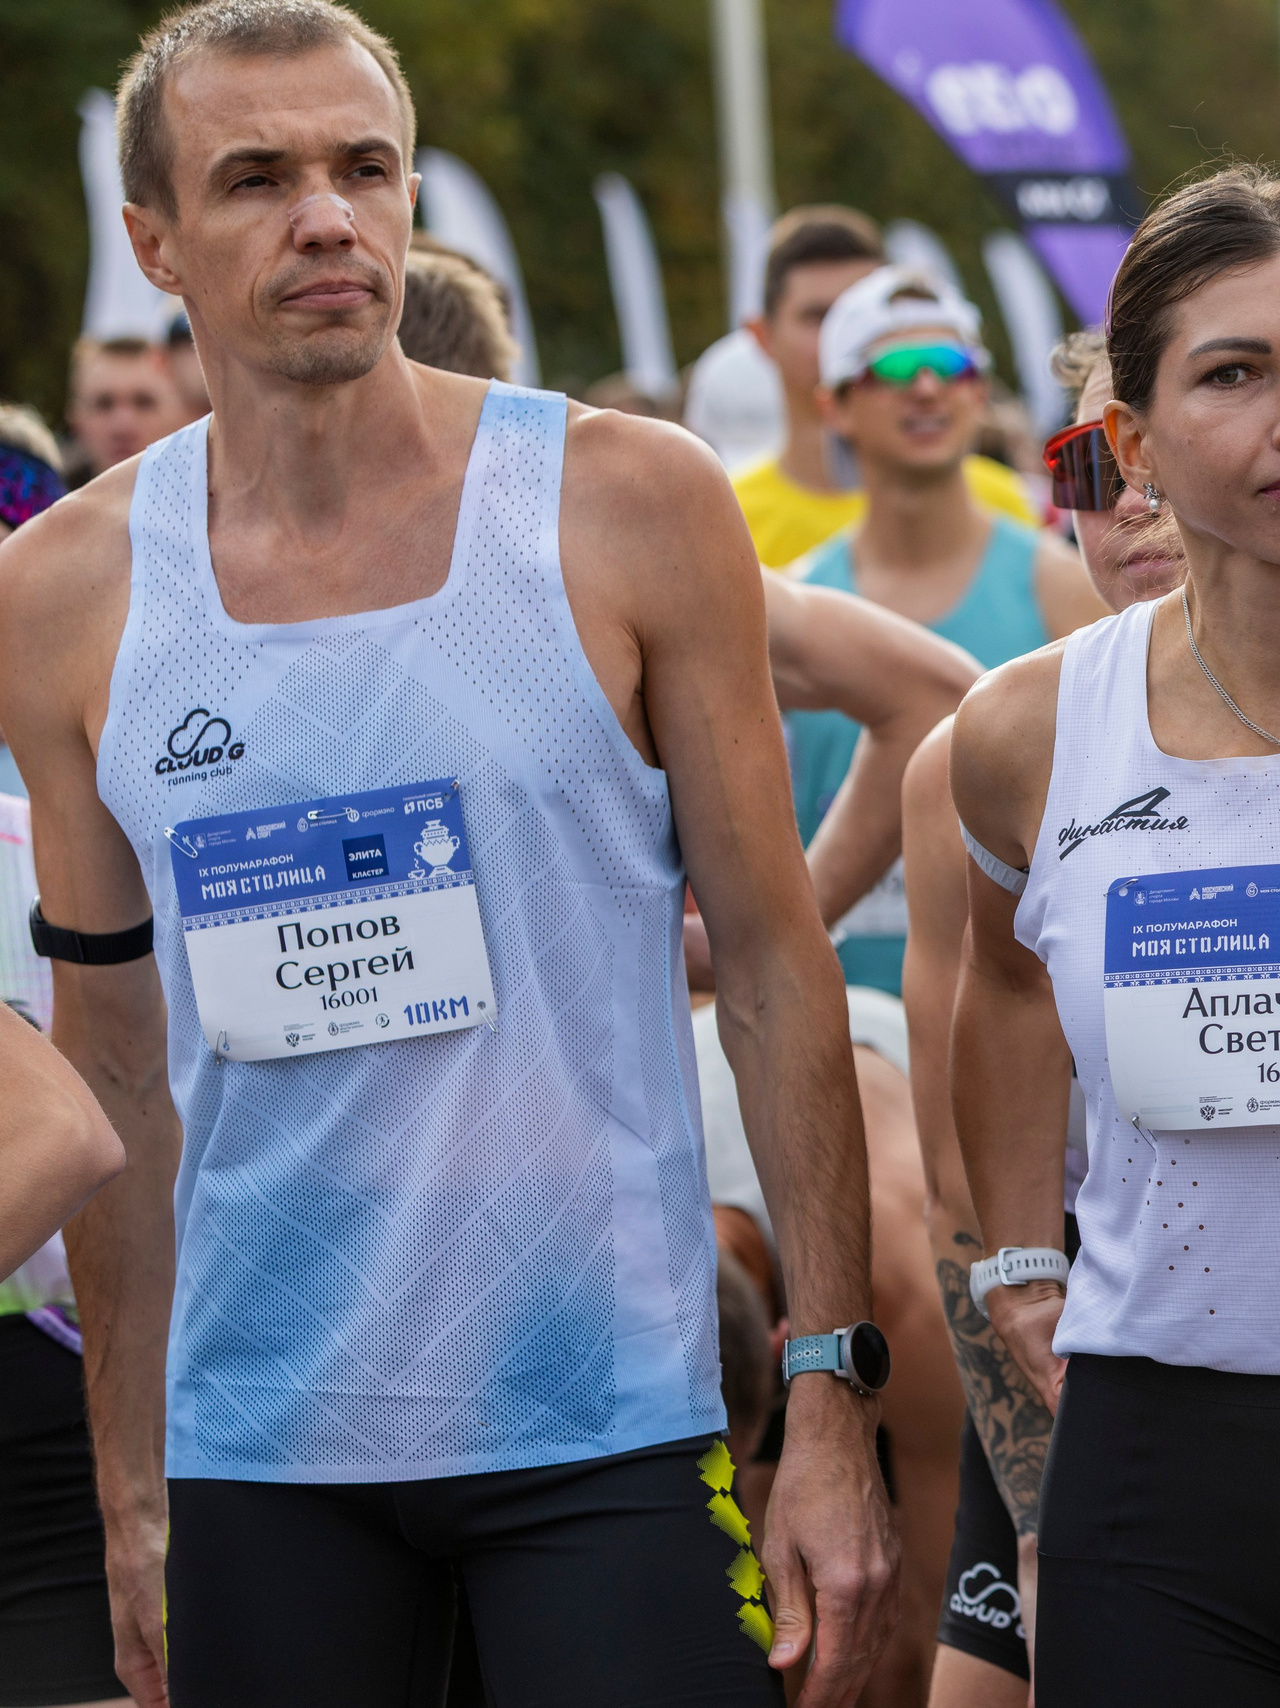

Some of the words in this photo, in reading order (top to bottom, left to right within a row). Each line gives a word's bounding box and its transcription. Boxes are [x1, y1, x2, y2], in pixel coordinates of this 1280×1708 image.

[168, 771, 207, 787] running
[210, 766, 233, 778] club
[417, 797, 444, 812] ПСБ
[198, 868, 209, 878] IX
[211, 854, 294, 875] ПОЛУМАРАФОН
[348, 848, 383, 862] ЭЛИТА
[201, 879, 238, 900] МОЯ
[240, 865, 326, 895] СТОЛИЦА
[352, 868, 384, 879] КЛАСТЕР
[276, 915, 401, 953] Попов
[1132, 925, 1143, 934] IX
[1146, 918, 1238, 933] ПОЛУМАРАФОН
[1132, 938, 1171, 958] МОЯ
[1175, 933, 1270, 955] СТОЛИЦА
[275, 945, 415, 991] Сергей
[319, 987, 379, 1011] 16001
